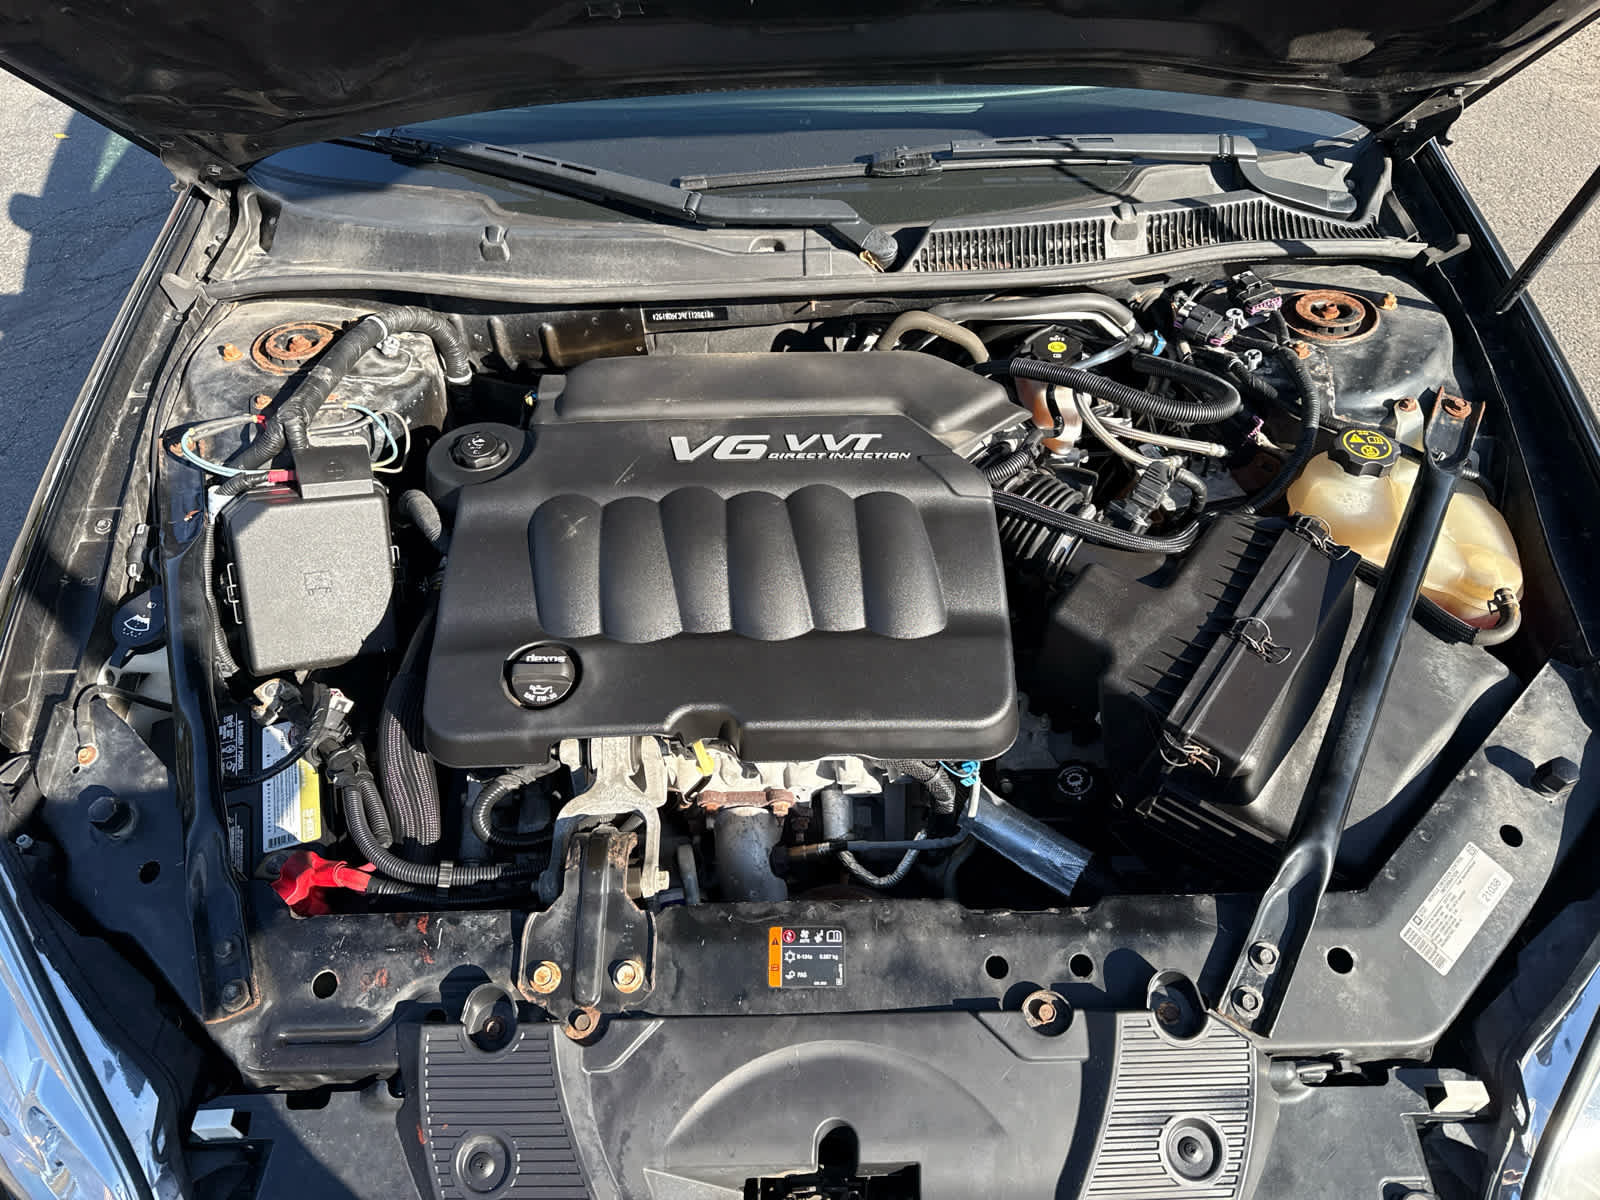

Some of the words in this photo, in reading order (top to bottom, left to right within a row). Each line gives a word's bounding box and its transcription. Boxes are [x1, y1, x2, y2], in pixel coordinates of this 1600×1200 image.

[670, 435, 770, 461] V6
[785, 433, 882, 452] VVT
[768, 452, 826, 460] DIRECT
[828, 452, 911, 460] INJECTION
[526, 654, 567, 662] dexos
